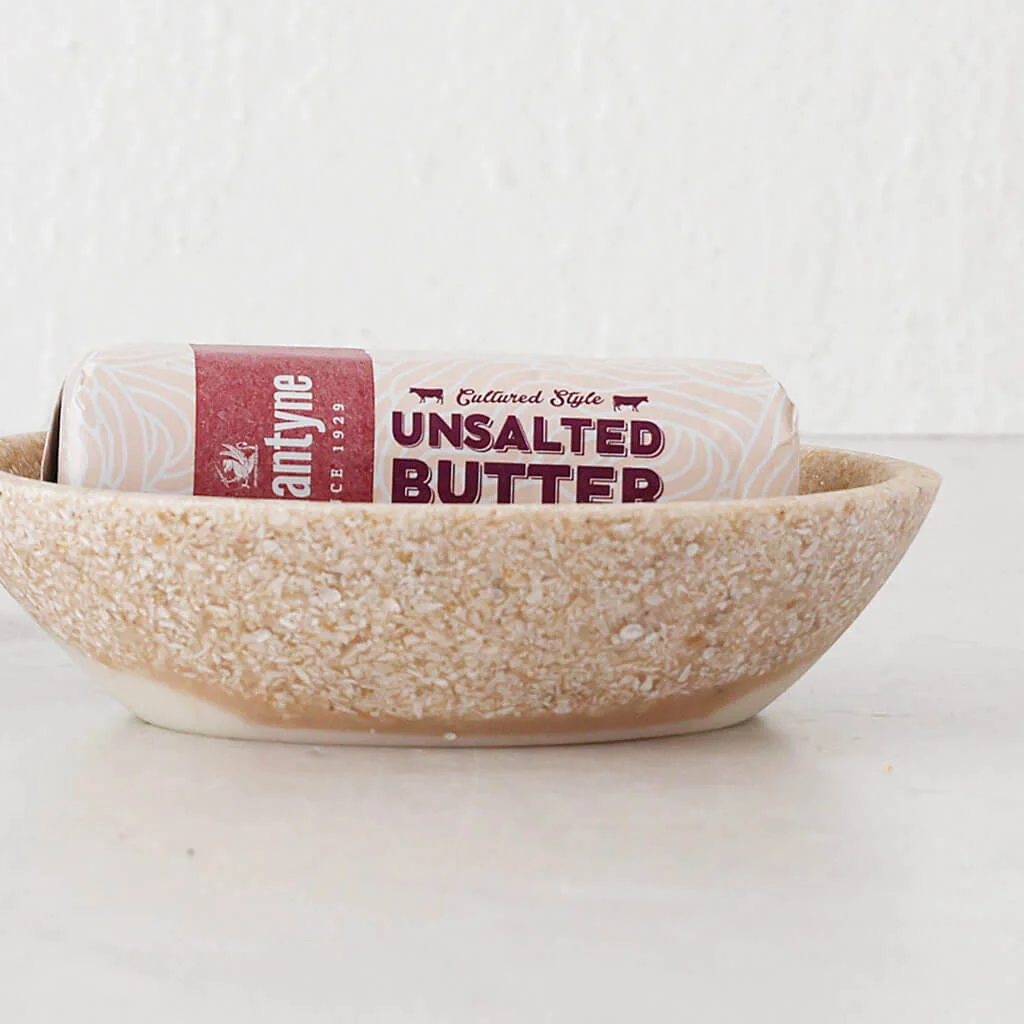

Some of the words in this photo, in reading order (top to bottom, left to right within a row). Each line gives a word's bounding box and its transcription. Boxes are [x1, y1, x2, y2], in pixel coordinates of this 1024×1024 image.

[456, 388, 543, 406] Cultured
[549, 389, 604, 408] Style
[332, 403, 344, 452] 1929
[392, 411, 665, 458] UNSALTED
[391, 458, 664, 504] BUTTER
